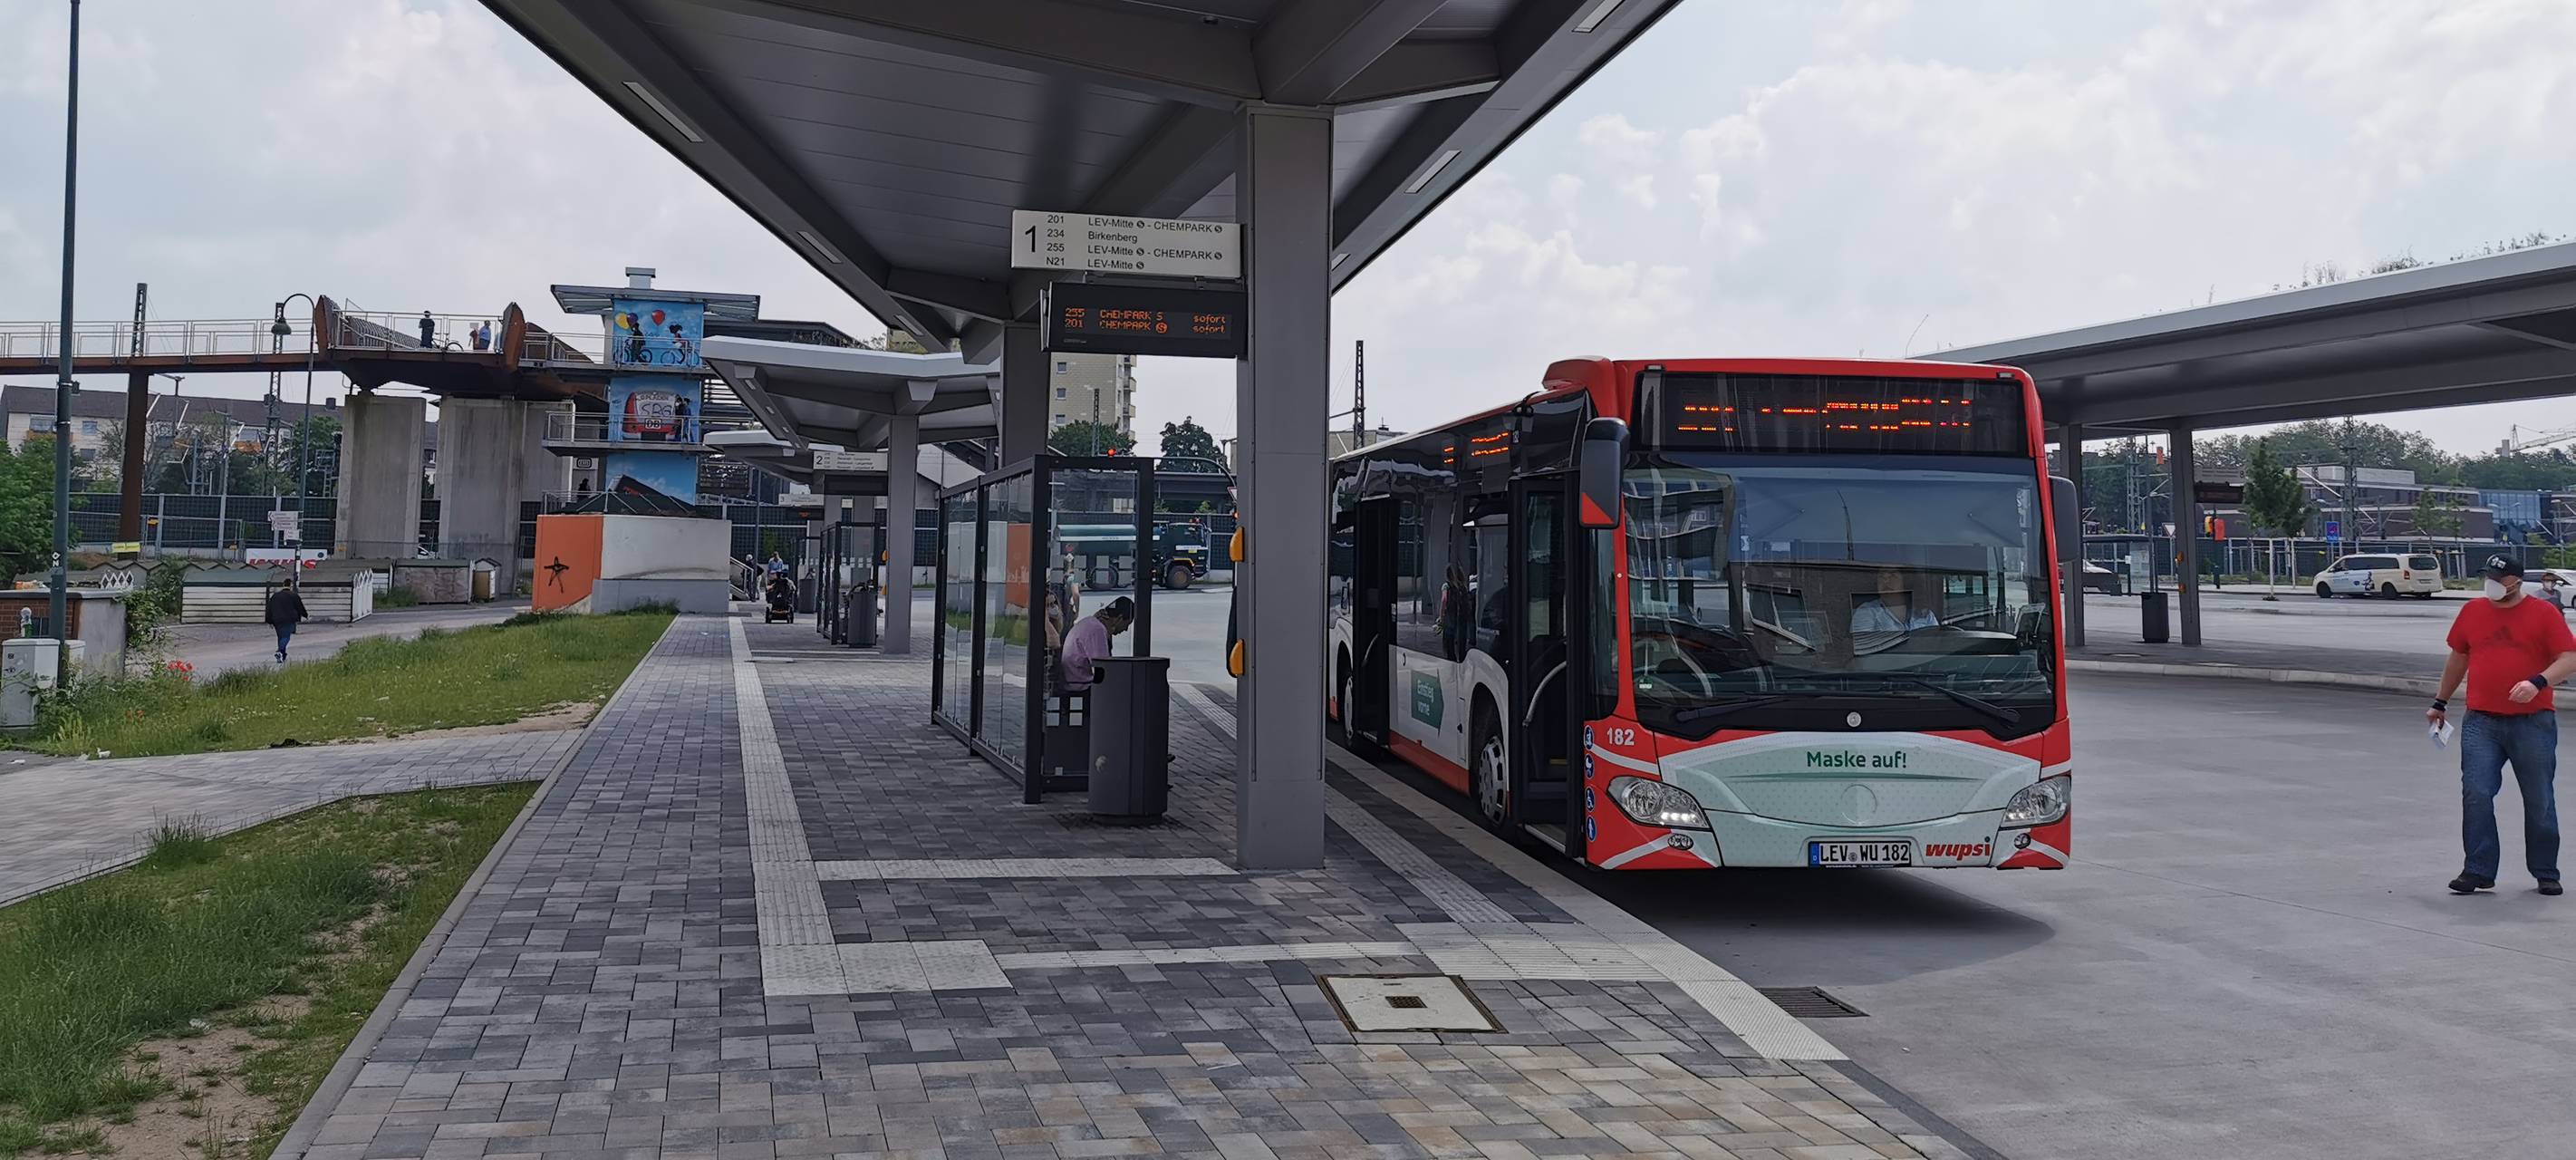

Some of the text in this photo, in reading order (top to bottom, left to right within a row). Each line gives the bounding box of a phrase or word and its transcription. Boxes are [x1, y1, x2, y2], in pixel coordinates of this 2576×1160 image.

[1047, 215, 1064, 224] 201
[1088, 218, 1134, 228] LEV-Mitte
[1153, 221, 1212, 233] CHEMPARK
[1025, 225, 1036, 253] 1
[1047, 228, 1138, 244] 234 Birkenberg
[1047, 243, 1065, 252] 255
[1087, 246, 1134, 256] LEV-Mitte
[1153, 248, 1212, 260] CHEMPARK
[1046, 256, 1065, 266] N21
[1087, 259, 1133, 269] LEV-Mitte
[1065, 307, 1226, 326] 255 CHEMPARK S sofort
[1065, 318, 1084, 328] 201
[1099, 320, 1151, 332] CHEMPARK
[1192, 324, 1225, 335] sofort
[815, 456, 824, 465] 2
[1606, 727, 1635, 746] 182
[1807, 750, 1906, 768] Maske auf!
[1820, 845, 1848, 862] LEV
[1860, 844, 1878, 862] WU
[1882, 844, 1909, 862] 182
[1925, 836, 1991, 861] wupsi
